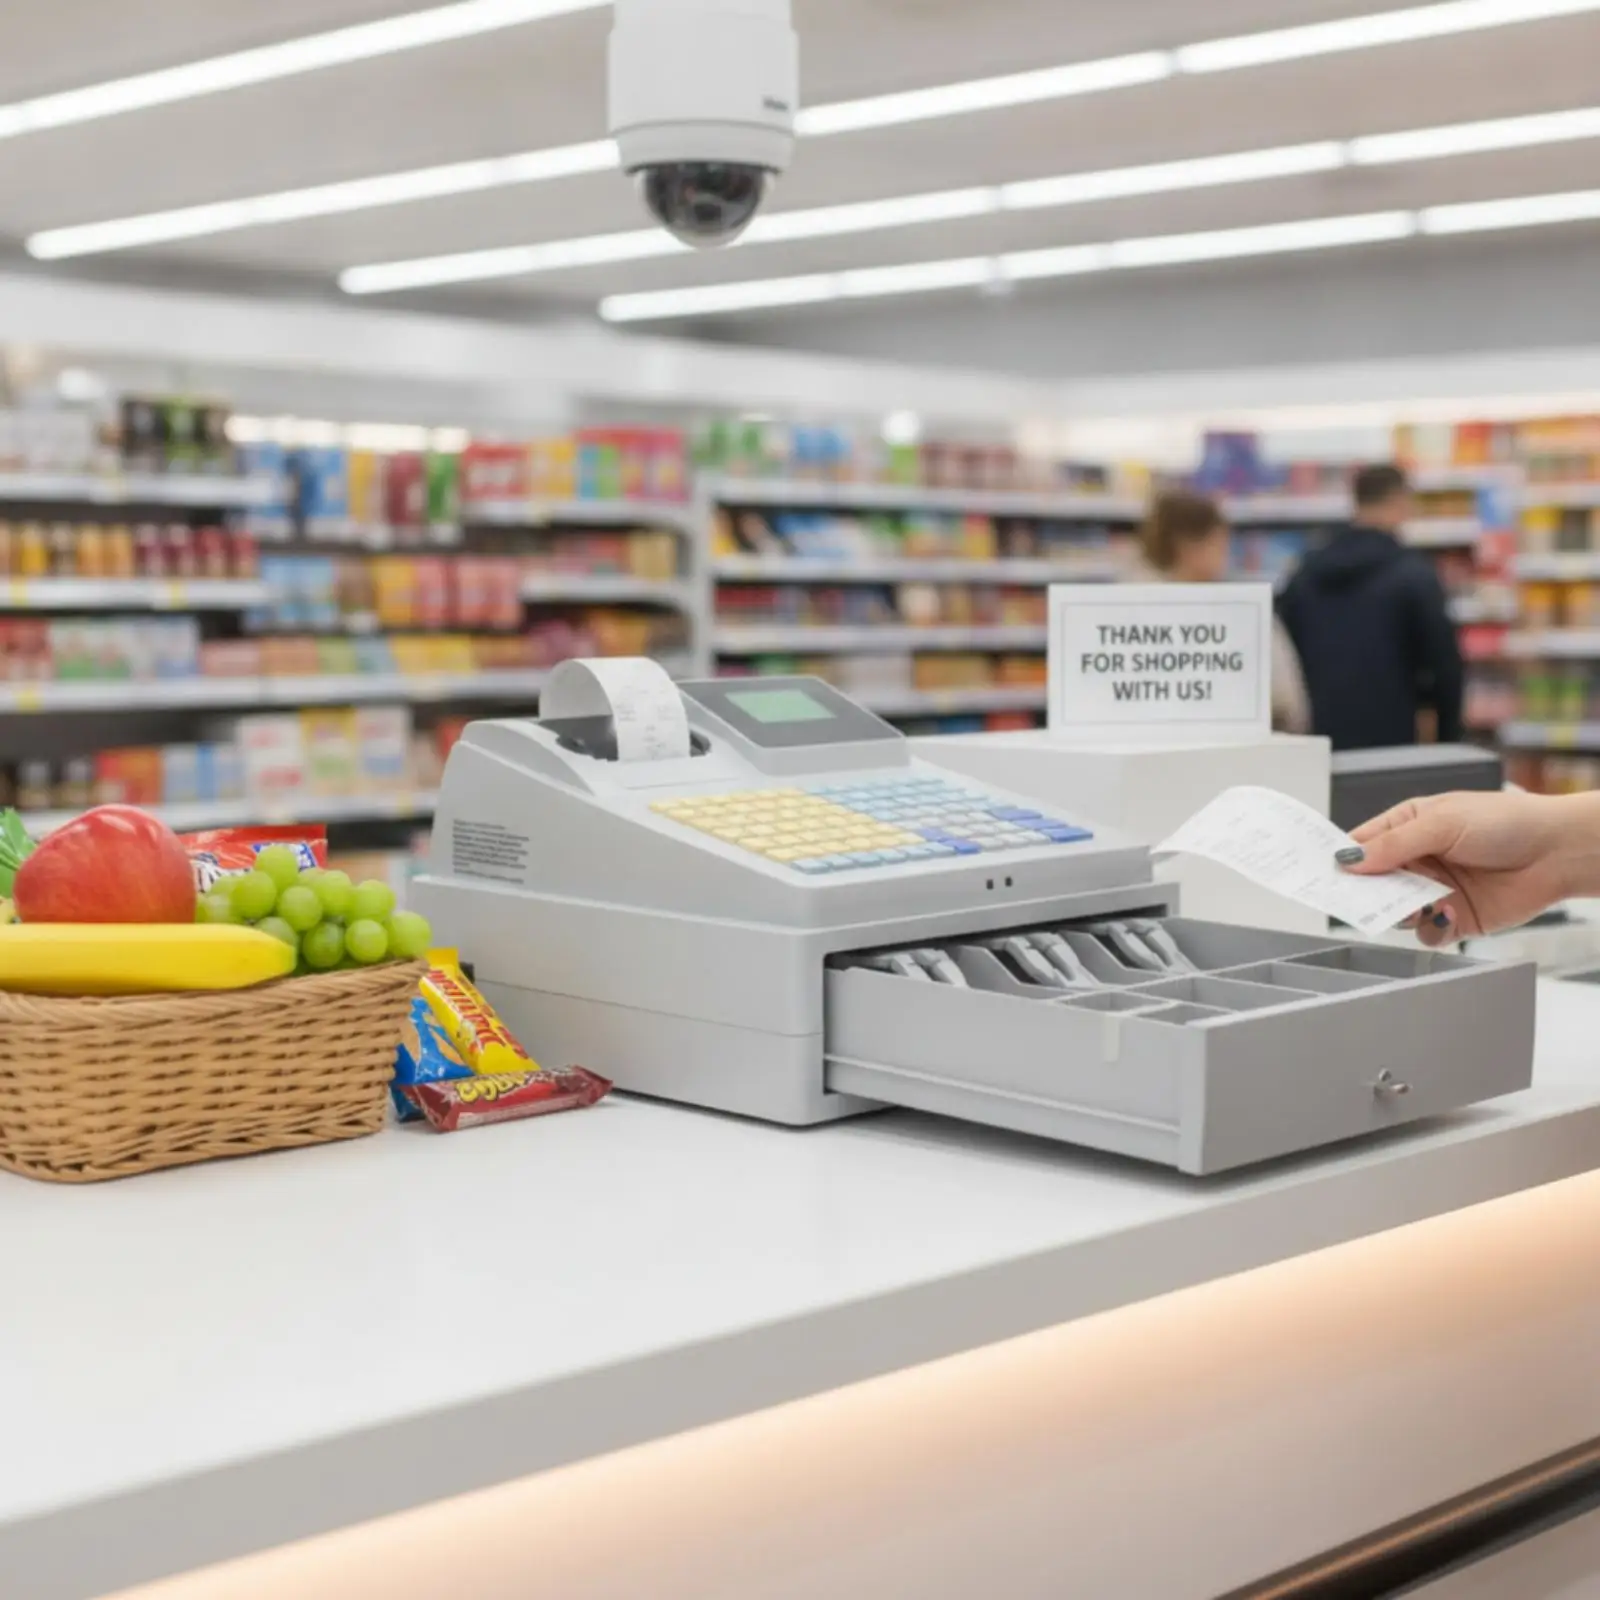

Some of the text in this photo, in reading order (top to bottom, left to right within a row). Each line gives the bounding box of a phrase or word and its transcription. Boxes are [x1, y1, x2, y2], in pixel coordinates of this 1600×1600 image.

[1097, 624, 1227, 645] THANK YOU
[1081, 652, 1244, 673] FOR SHOPPING
[1112, 681, 1212, 701] WITH US!
